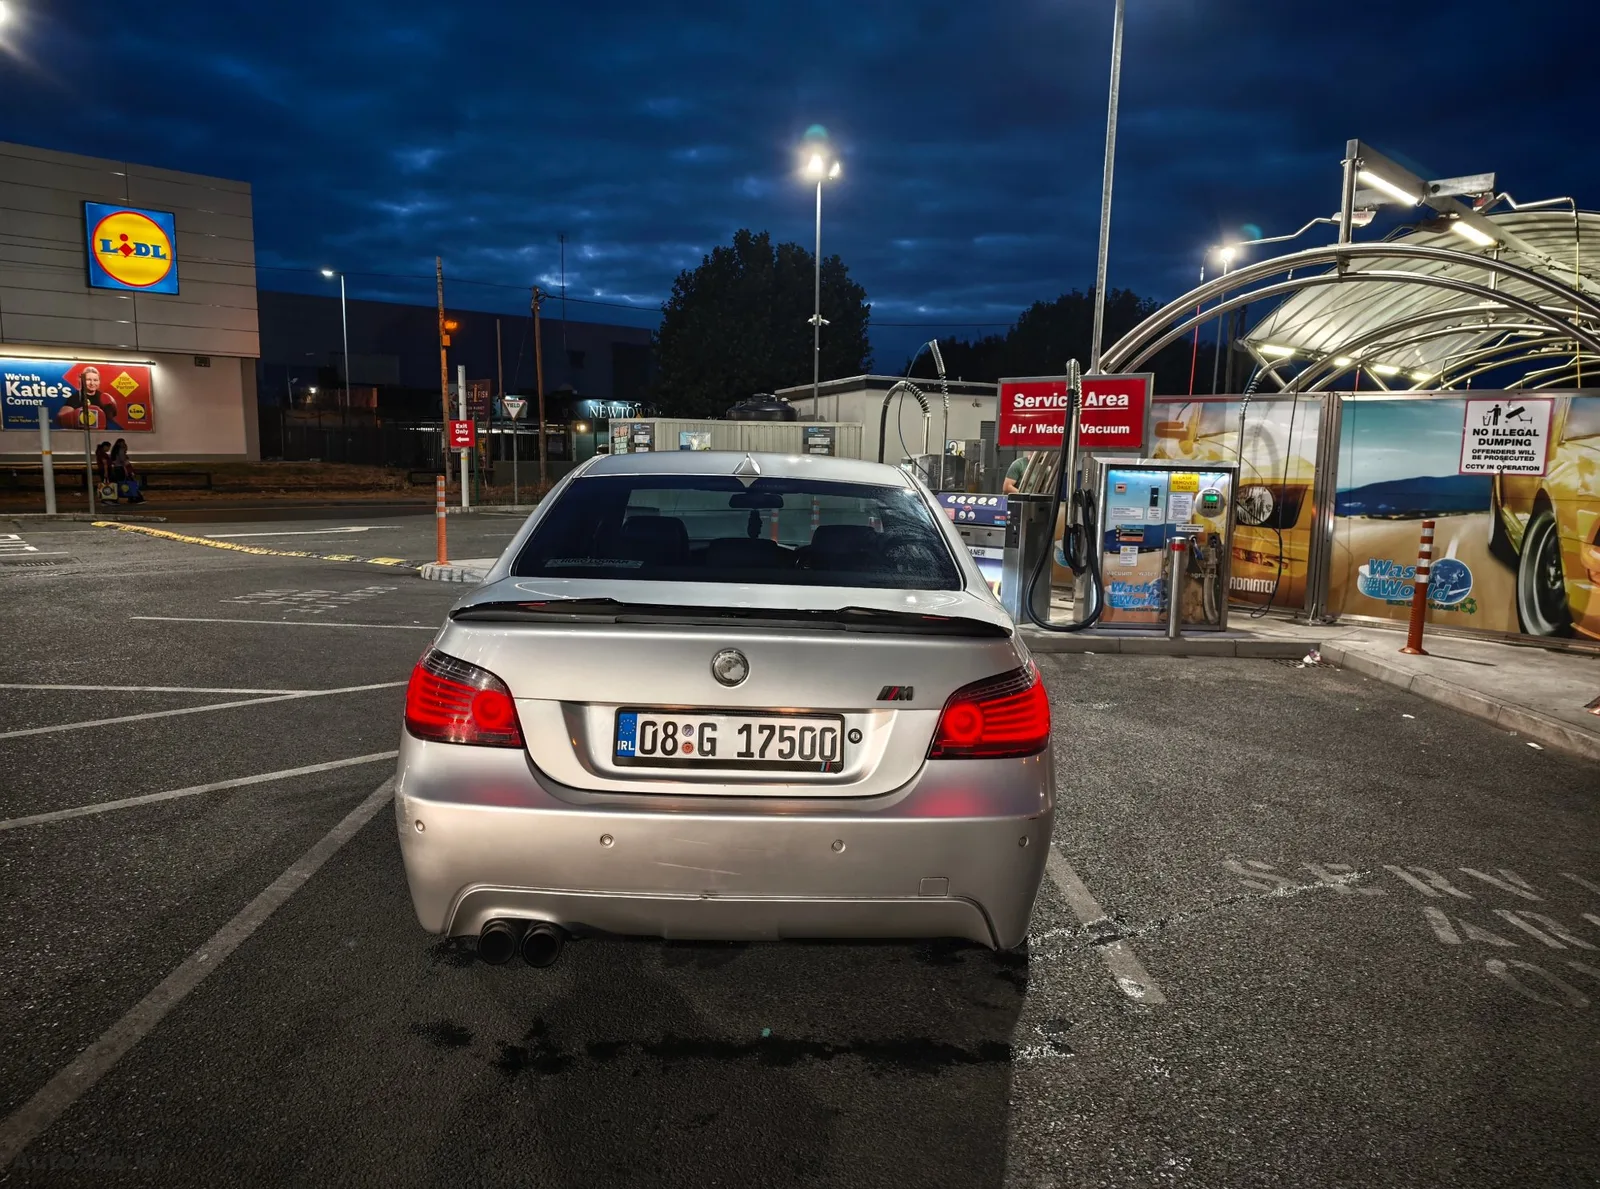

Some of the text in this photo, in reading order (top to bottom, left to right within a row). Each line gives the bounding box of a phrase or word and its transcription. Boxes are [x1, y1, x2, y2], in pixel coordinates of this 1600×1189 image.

[5, 373, 30, 381] We're
[5, 381, 72, 398] Katie's
[6, 397, 43, 405] Corner
[1013, 391, 1129, 408] Servic Area
[1009, 423, 1130, 434] Air / Wate Vacuum
[1472, 428, 1540, 437] NO ILLEGAL
[1477, 438, 1532, 447] DUMPING
[1471, 448, 1516, 456] OFFENDERS
[1368, 558, 1417, 579] Was
[1111, 581, 1153, 594] Wash
[1380, 578, 1452, 601] Wold
[617, 740, 635, 751] IRL
[638, 720, 838, 761] 08 G 17500
